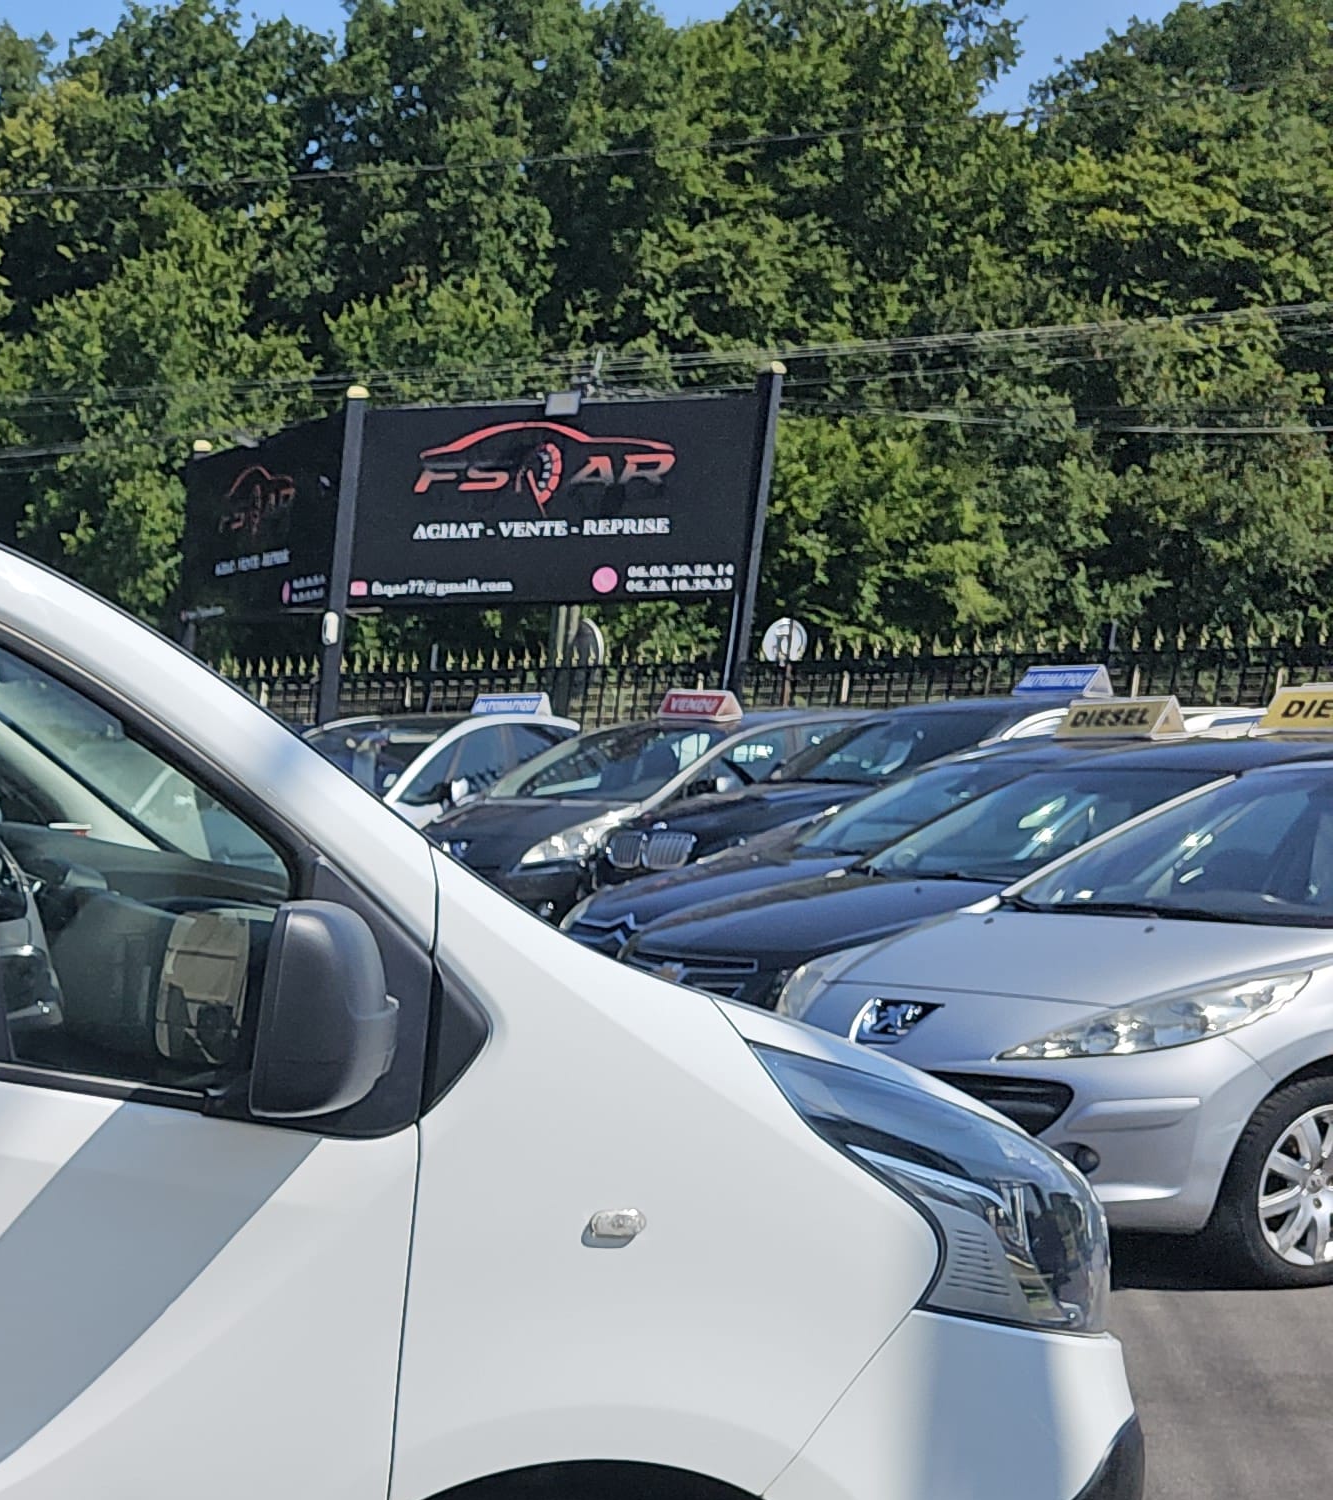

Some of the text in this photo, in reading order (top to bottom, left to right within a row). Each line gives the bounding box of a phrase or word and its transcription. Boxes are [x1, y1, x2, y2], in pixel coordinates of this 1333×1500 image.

[412, 522, 483, 539] ACHAT
[498, 520, 568, 537] VENTE
[582, 518, 670, 535] REPRISE
[1070, 707, 1149, 728] DIESEL
